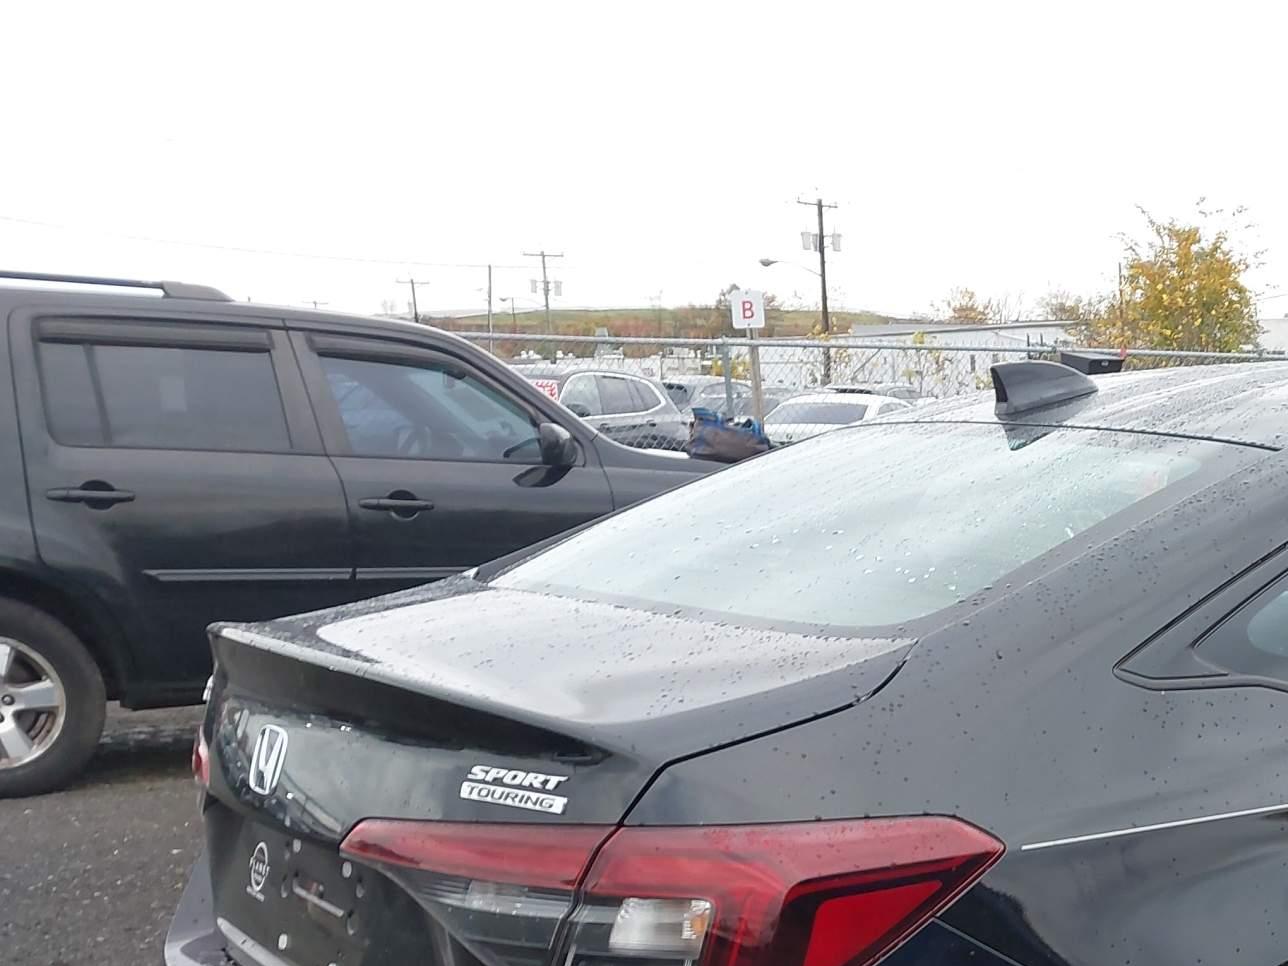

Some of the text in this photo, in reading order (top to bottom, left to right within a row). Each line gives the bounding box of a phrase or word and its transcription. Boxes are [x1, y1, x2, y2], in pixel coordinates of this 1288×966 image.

[742, 300, 755, 319] B
[466, 764, 569, 791] SPORT
[464, 783, 557, 810] TOURING
